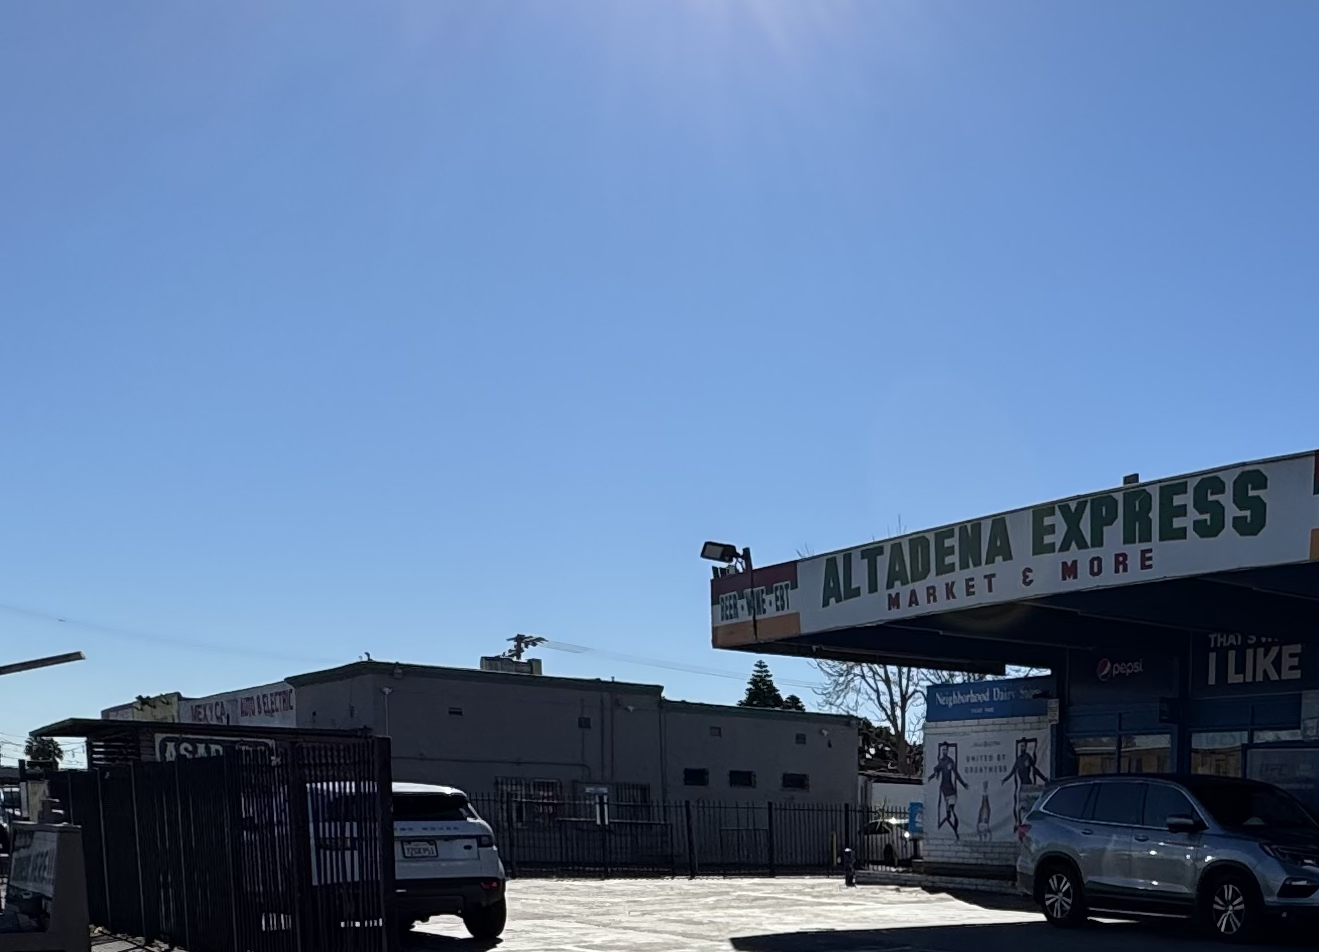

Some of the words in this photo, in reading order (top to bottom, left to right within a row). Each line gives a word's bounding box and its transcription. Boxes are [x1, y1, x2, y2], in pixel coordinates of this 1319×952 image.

[821, 516, 1013, 608] ALTADENA
[1032, 469, 1268, 556] EXPRESS
[887, 573, 996, 611] MARKET
[1021, 567, 1034, 587] &
[1061, 548, 1153, 581] MORE
[1112, 658, 1144, 678] pepsi
[1207, 651, 1217, 685] I
[1227, 643, 1302, 684] LIKE
